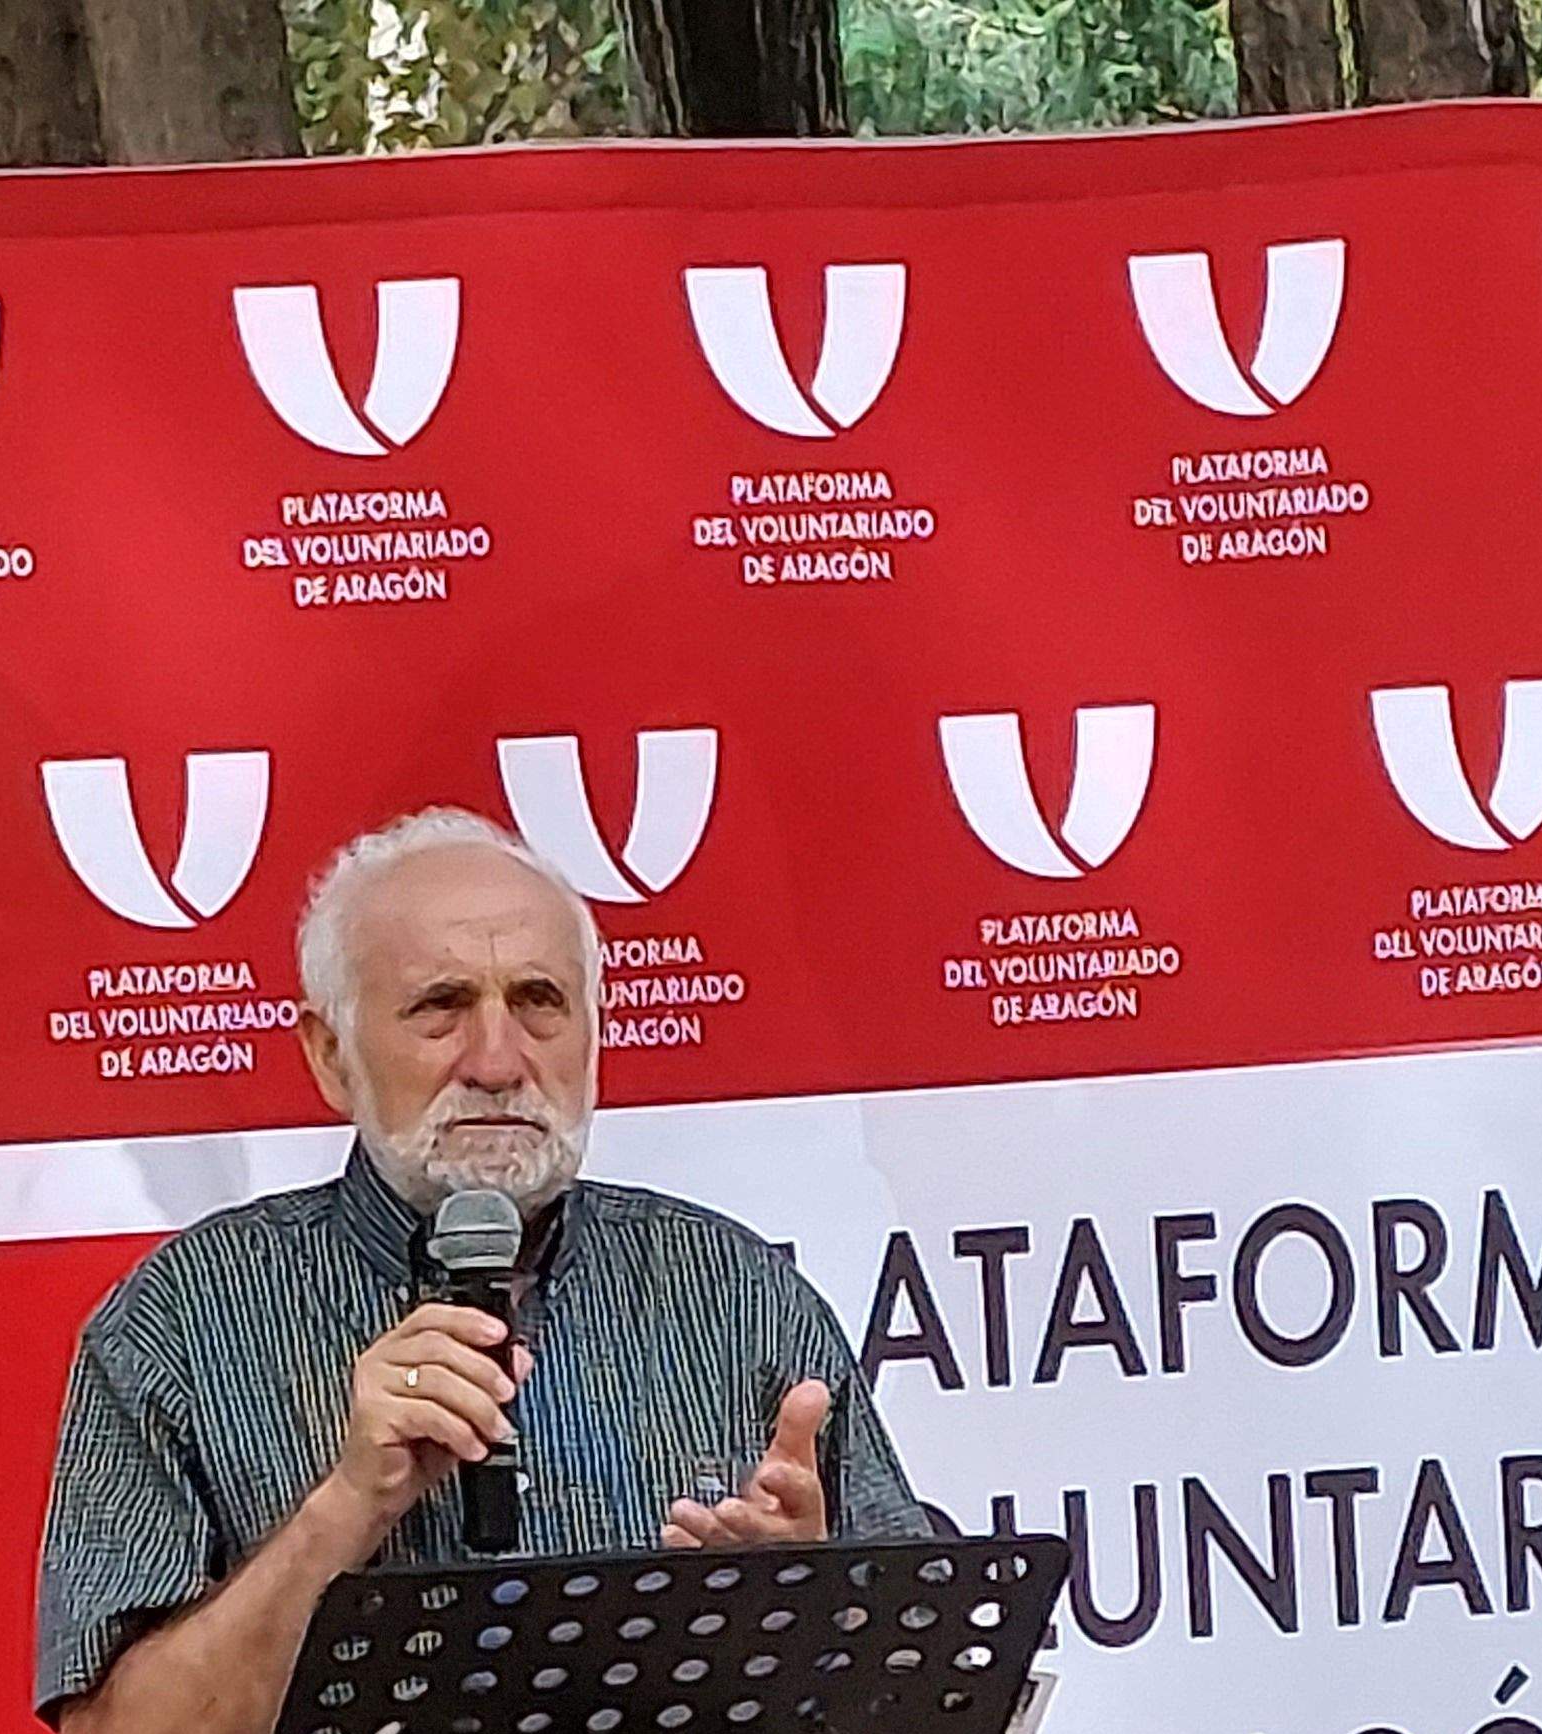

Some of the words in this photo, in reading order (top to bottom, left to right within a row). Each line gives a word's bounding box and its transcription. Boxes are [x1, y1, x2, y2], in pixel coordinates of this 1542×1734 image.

[1171, 446, 1329, 485] PLATAFORMA
[730, 470, 893, 505] PLATAFORMA
[1133, 496, 1178, 527] DEL
[1178, 482, 1370, 524] VOLUNTARIADO
[281, 489, 448, 527] PLATAFORMA
[692, 516, 739, 547] DEL
[739, 508, 935, 545] VOLUNTARIADO
[242, 537, 291, 569] DEL
[290, 525, 491, 566] VOLUNTARIADO
[742, 553, 777, 585] DE
[779, 544, 893, 582] ARAGÓN
[1181, 532, 1214, 565] DE
[1217, 525, 1327, 560] ARAGÓN
[294, 574, 329, 608] DE
[332, 565, 448, 605] ARAGÓN
[980, 908, 1140, 946] PLATAFORMA
[1373, 928, 1418, 960] DEL
[600, 934, 704, 969] AFORMA
[943, 958, 988, 989] DEL
[988, 945, 1181, 986] VOLUNTARIADO
[87, 961, 257, 1000] PLATAFORMA
[600, 973, 746, 1011] UNTARIADO
[1419, 966, 1452, 998] DE
[49, 1010, 97, 1041] DEL
[98, 998, 300, 1038] VOLUNTARIADO
[991, 994, 1024, 1027] DE
[1023, 983, 1138, 1022] ARAGÓN
[99, 1046, 135, 1079] DE
[138, 1035, 254, 1076] ARAGÓN
